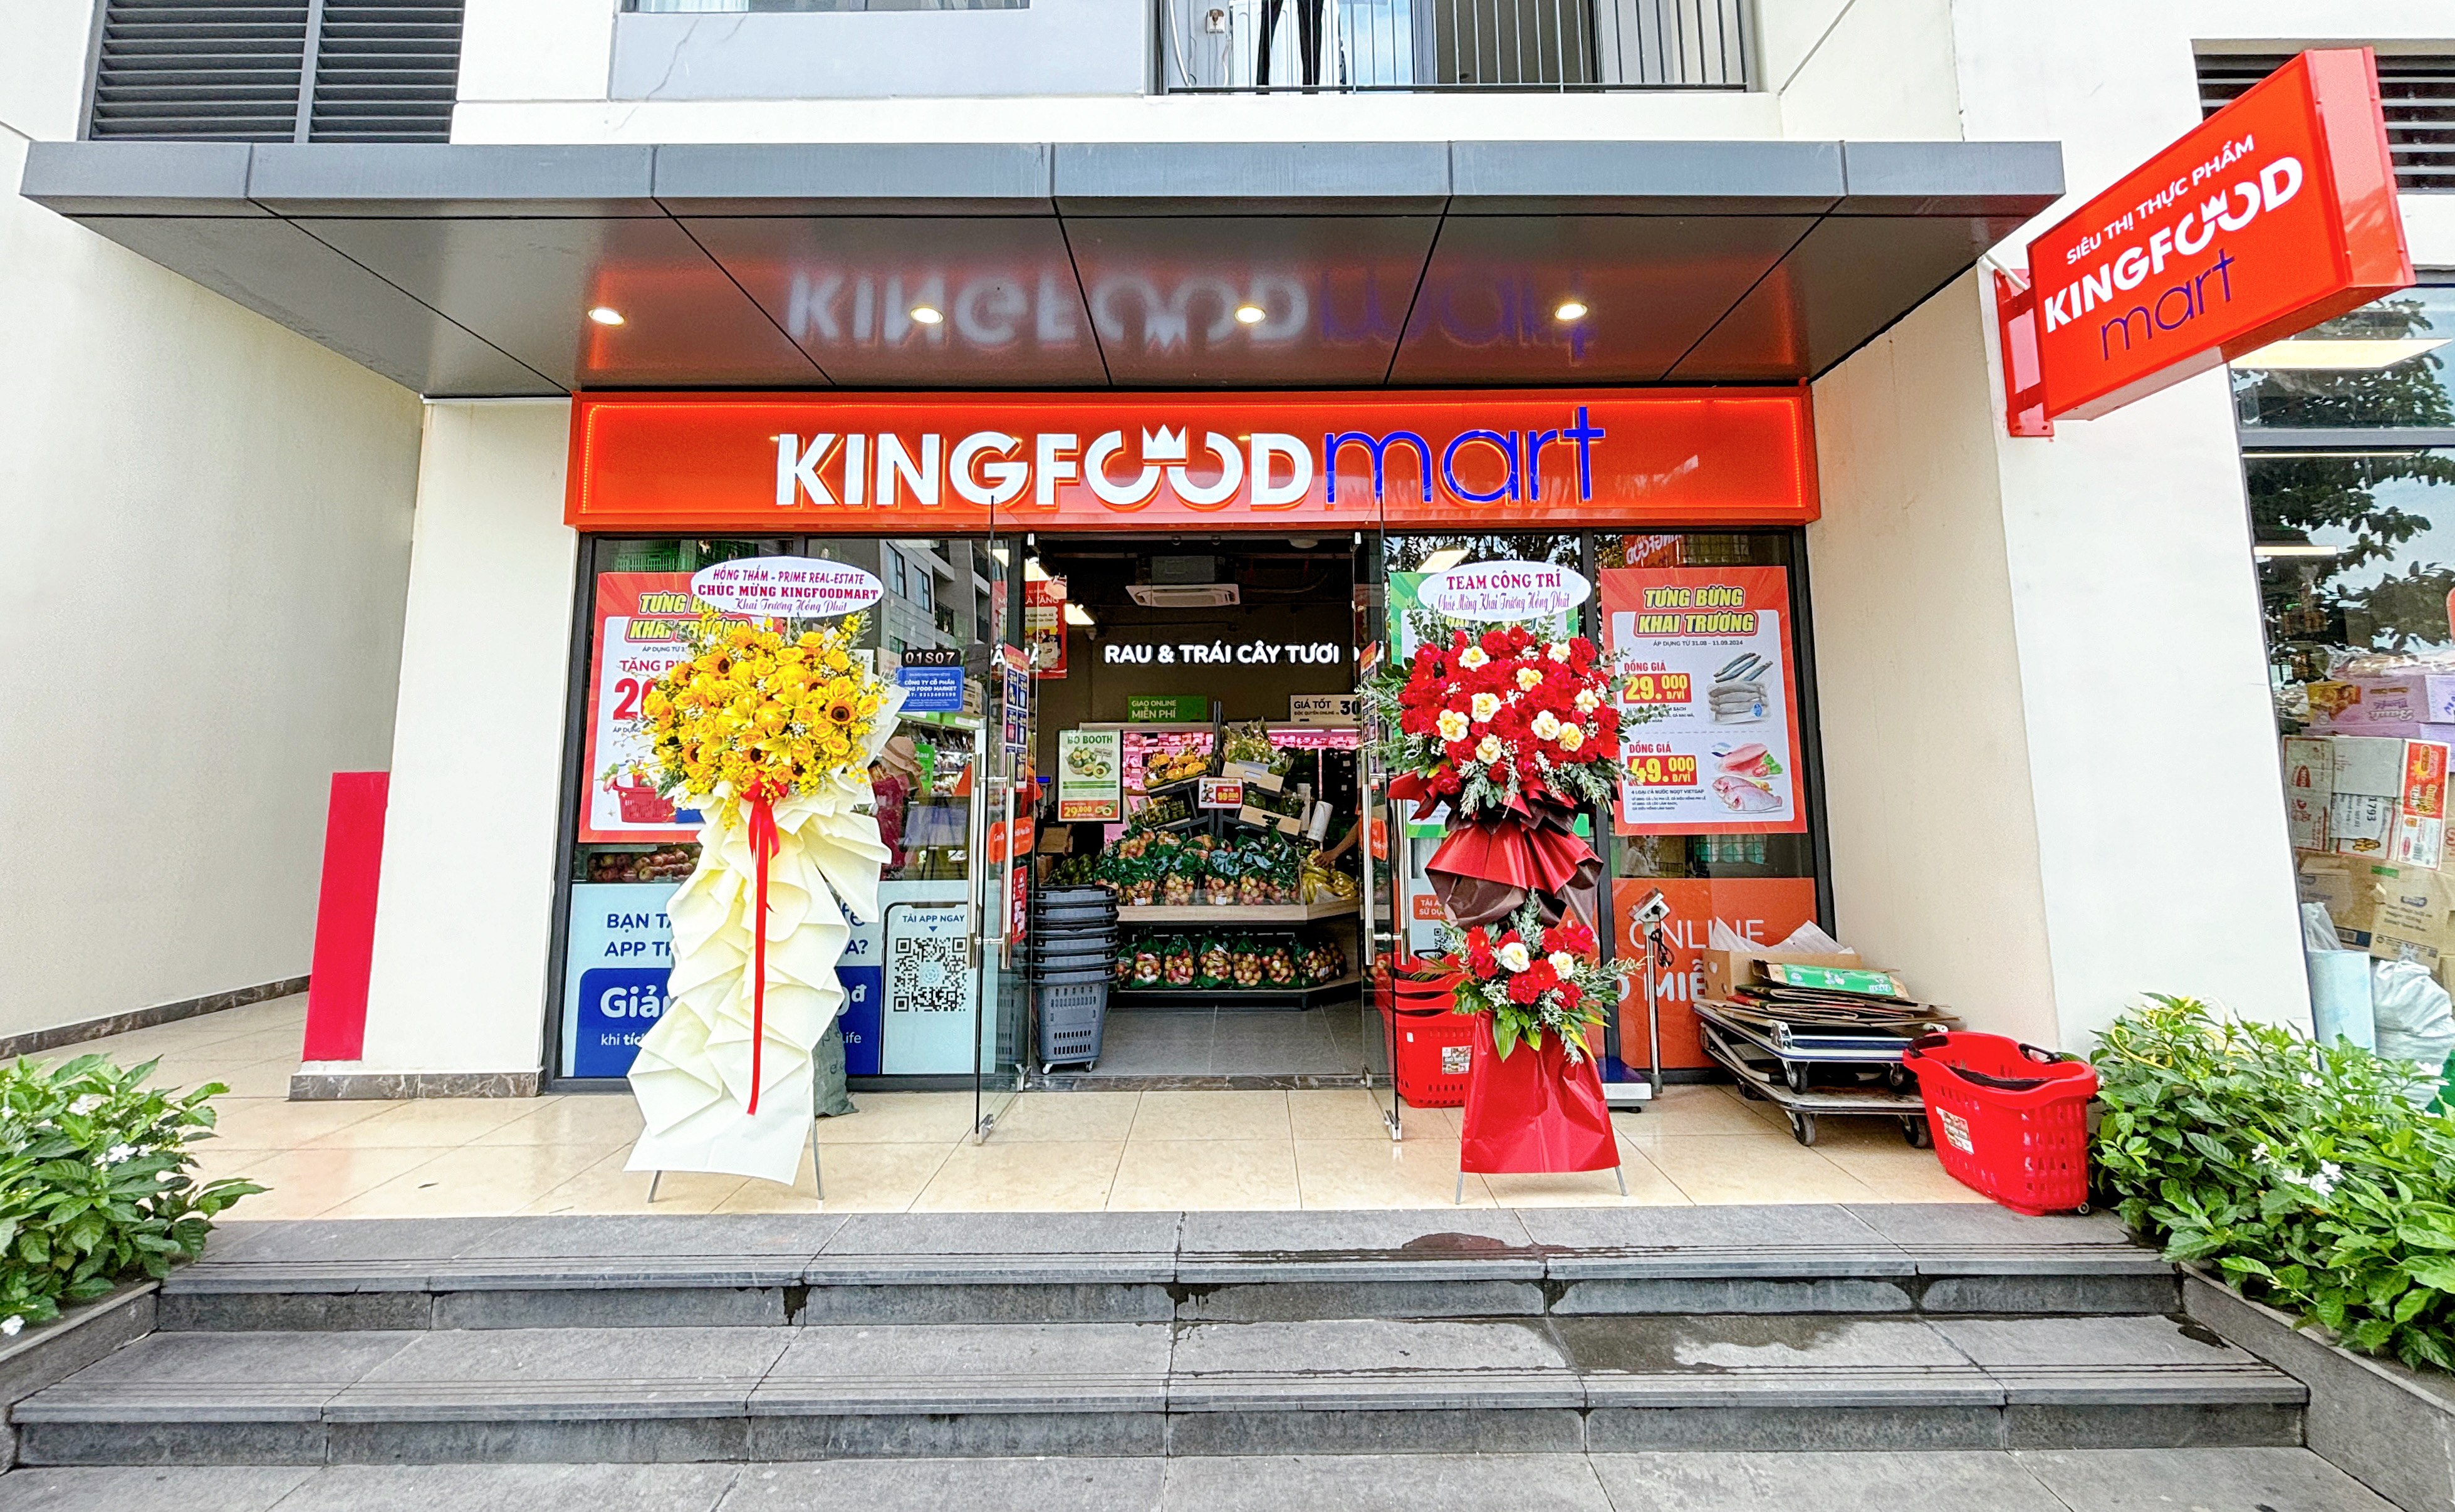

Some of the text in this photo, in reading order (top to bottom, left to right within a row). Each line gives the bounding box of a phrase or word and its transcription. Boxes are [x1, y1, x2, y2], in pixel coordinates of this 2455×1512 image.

[2067, 135, 2254, 264] SIÊU THỊ THỰC PHẨM
[2044, 157, 2303, 333] KINGFOOD
[2101, 248, 2235, 362] mart
[713, 564, 740, 581] HỒNG
[778, 571, 807, 583] PRIME
[809, 572, 865, 585] REAL-ESTATE
[1446, 569, 1561, 590] TEAM CÔNG TRÍ
[698, 581, 878, 600] CHÚC MỪNG KINGFOODMART
[1644, 585, 1744, 608] TƯNG BỪNG
[732, 598, 758, 610] Khai
[761, 598, 793, 613] Trương
[795, 599, 821, 613] Hồng
[824, 600, 847, 613] Phát
[1479, 593, 1498, 610] Khai
[1548, 591, 1570, 614] Phát
[1637, 611, 1755, 633] KHAI TRƯƠNG
[905, 652, 955, 664] 01S07
[1105, 644, 1152, 664] RAU
[1157, 645, 1175, 664] &
[1179, 640, 1231, 664] TRÁI
[1236, 641, 1281, 664] CÂY
[1284, 643, 1339, 664] TƯƠI
[1651, 660, 1666, 672] GIÁ
[1132, 699, 1177, 707] GIAO ONLINE
[1294, 699, 1311, 709] GIÁ
[1312, 698, 1332, 709] TỐT
[1132, 707, 1177, 719] MIỄN PHÍ
[1083, 735, 1113, 744] BOOTH
[1656, 741, 1672, 753] GIÁ
[607, 913, 649, 933] BẠN
[902, 913, 965, 923] TẢI APP NGAY
[604, 941, 647, 957] APP
[600, 1033, 620, 1046] khi
